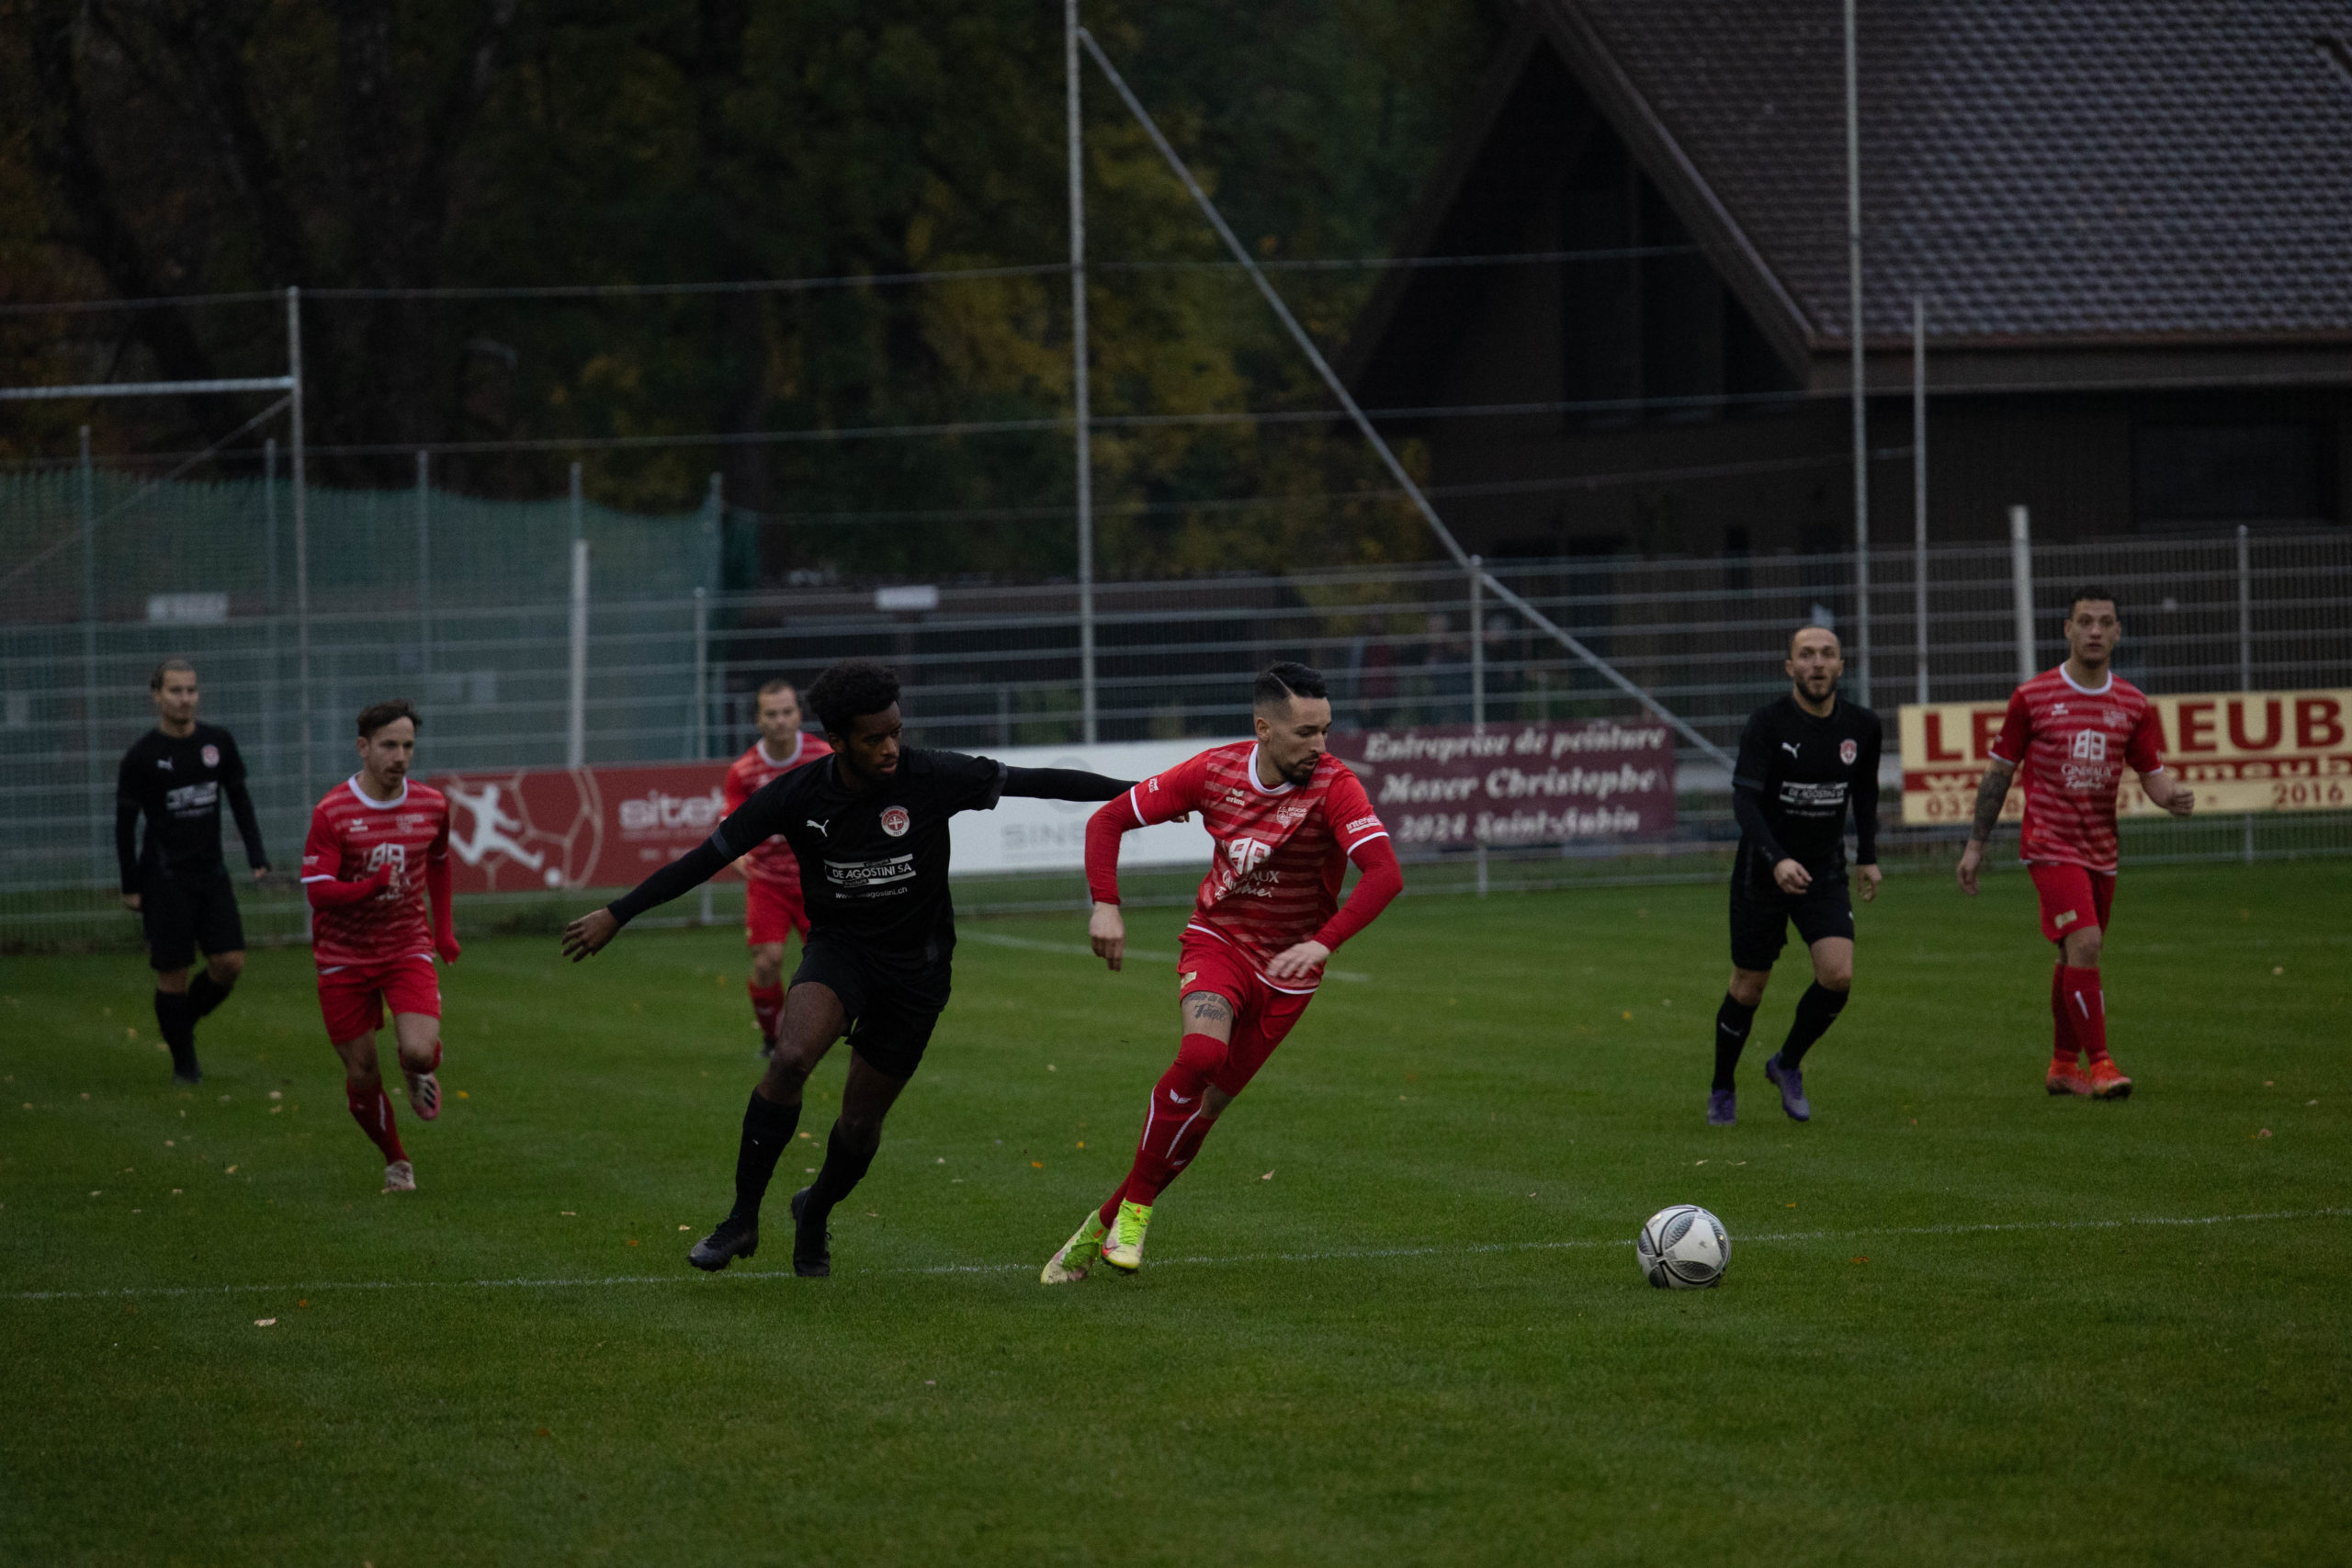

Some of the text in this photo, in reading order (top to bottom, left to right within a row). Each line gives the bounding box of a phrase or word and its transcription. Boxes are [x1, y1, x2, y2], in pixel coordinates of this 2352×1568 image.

[1363, 722, 1666, 765] Entreprise de peinture
[1485, 762, 1655, 801] Christophe
[2272, 783, 2344, 805] 2016
[831, 868, 845, 879] DE
[845, 865, 896, 879] AGOSTINI
[897, 862, 912, 874] SA
